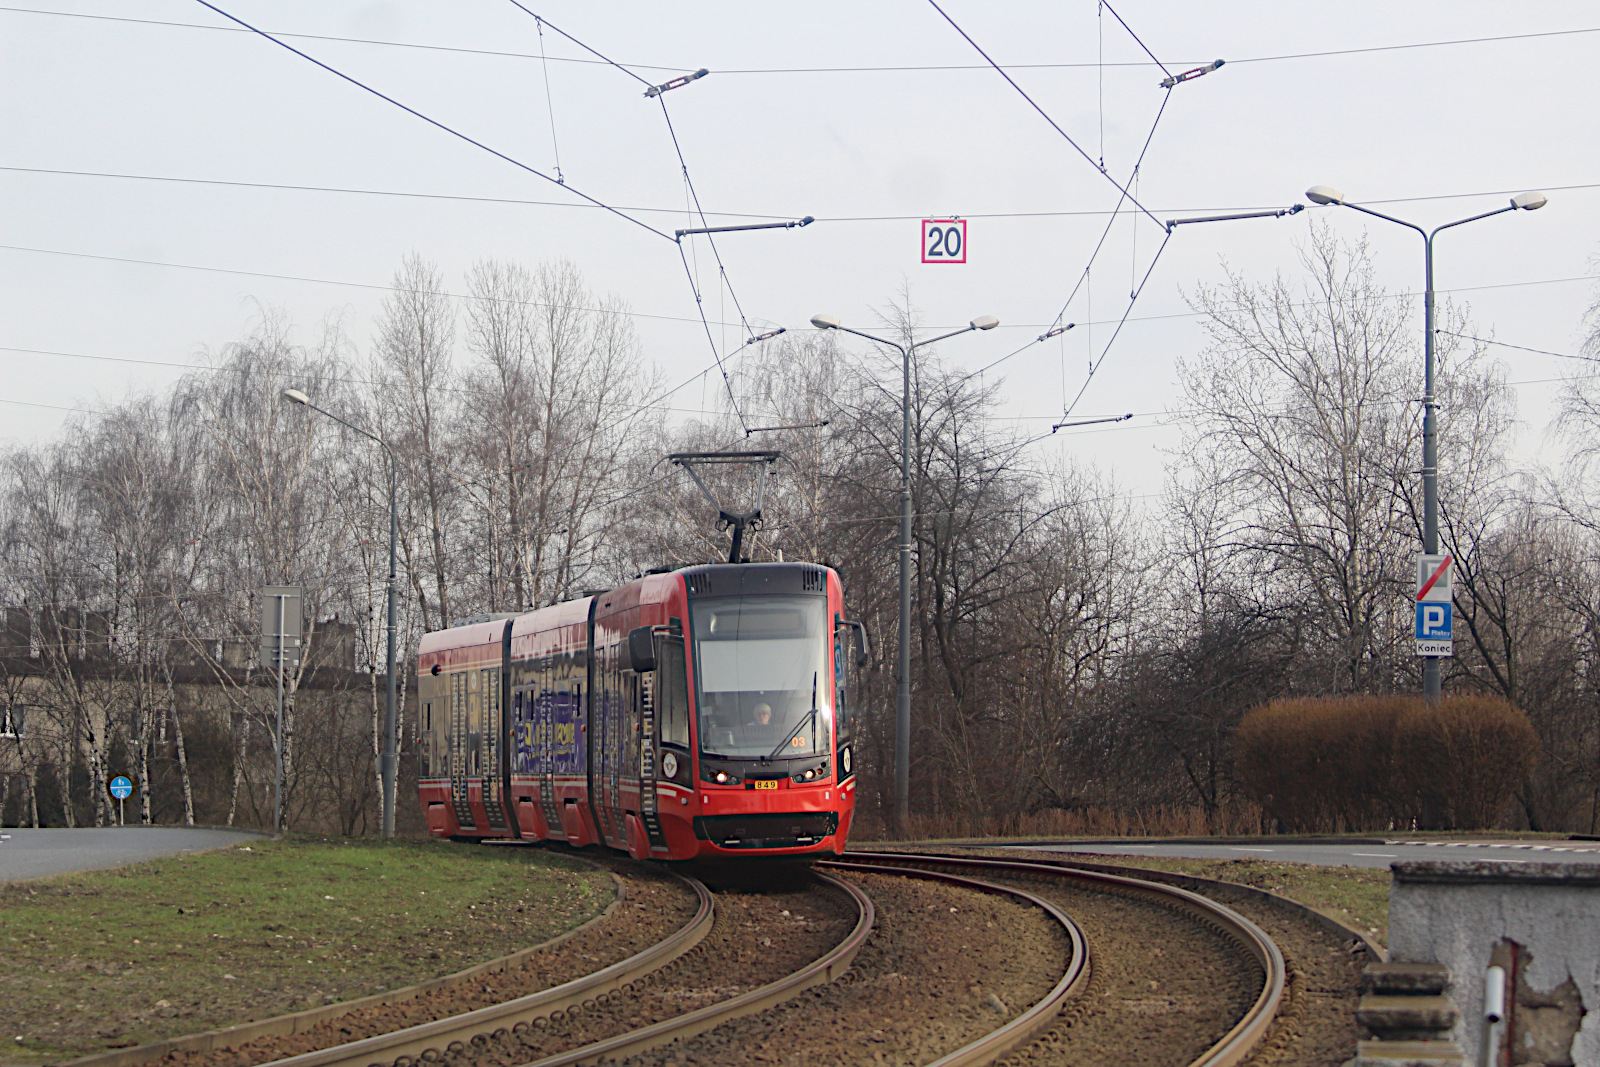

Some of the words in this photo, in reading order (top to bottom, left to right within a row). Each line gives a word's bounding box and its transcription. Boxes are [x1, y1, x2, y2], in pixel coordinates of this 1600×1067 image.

[928, 226, 962, 257] 20
[1423, 605, 1445, 636] P
[1417, 643, 1451, 653] Koniec
[791, 736, 806, 748] 03
[757, 781, 776, 789] 849
